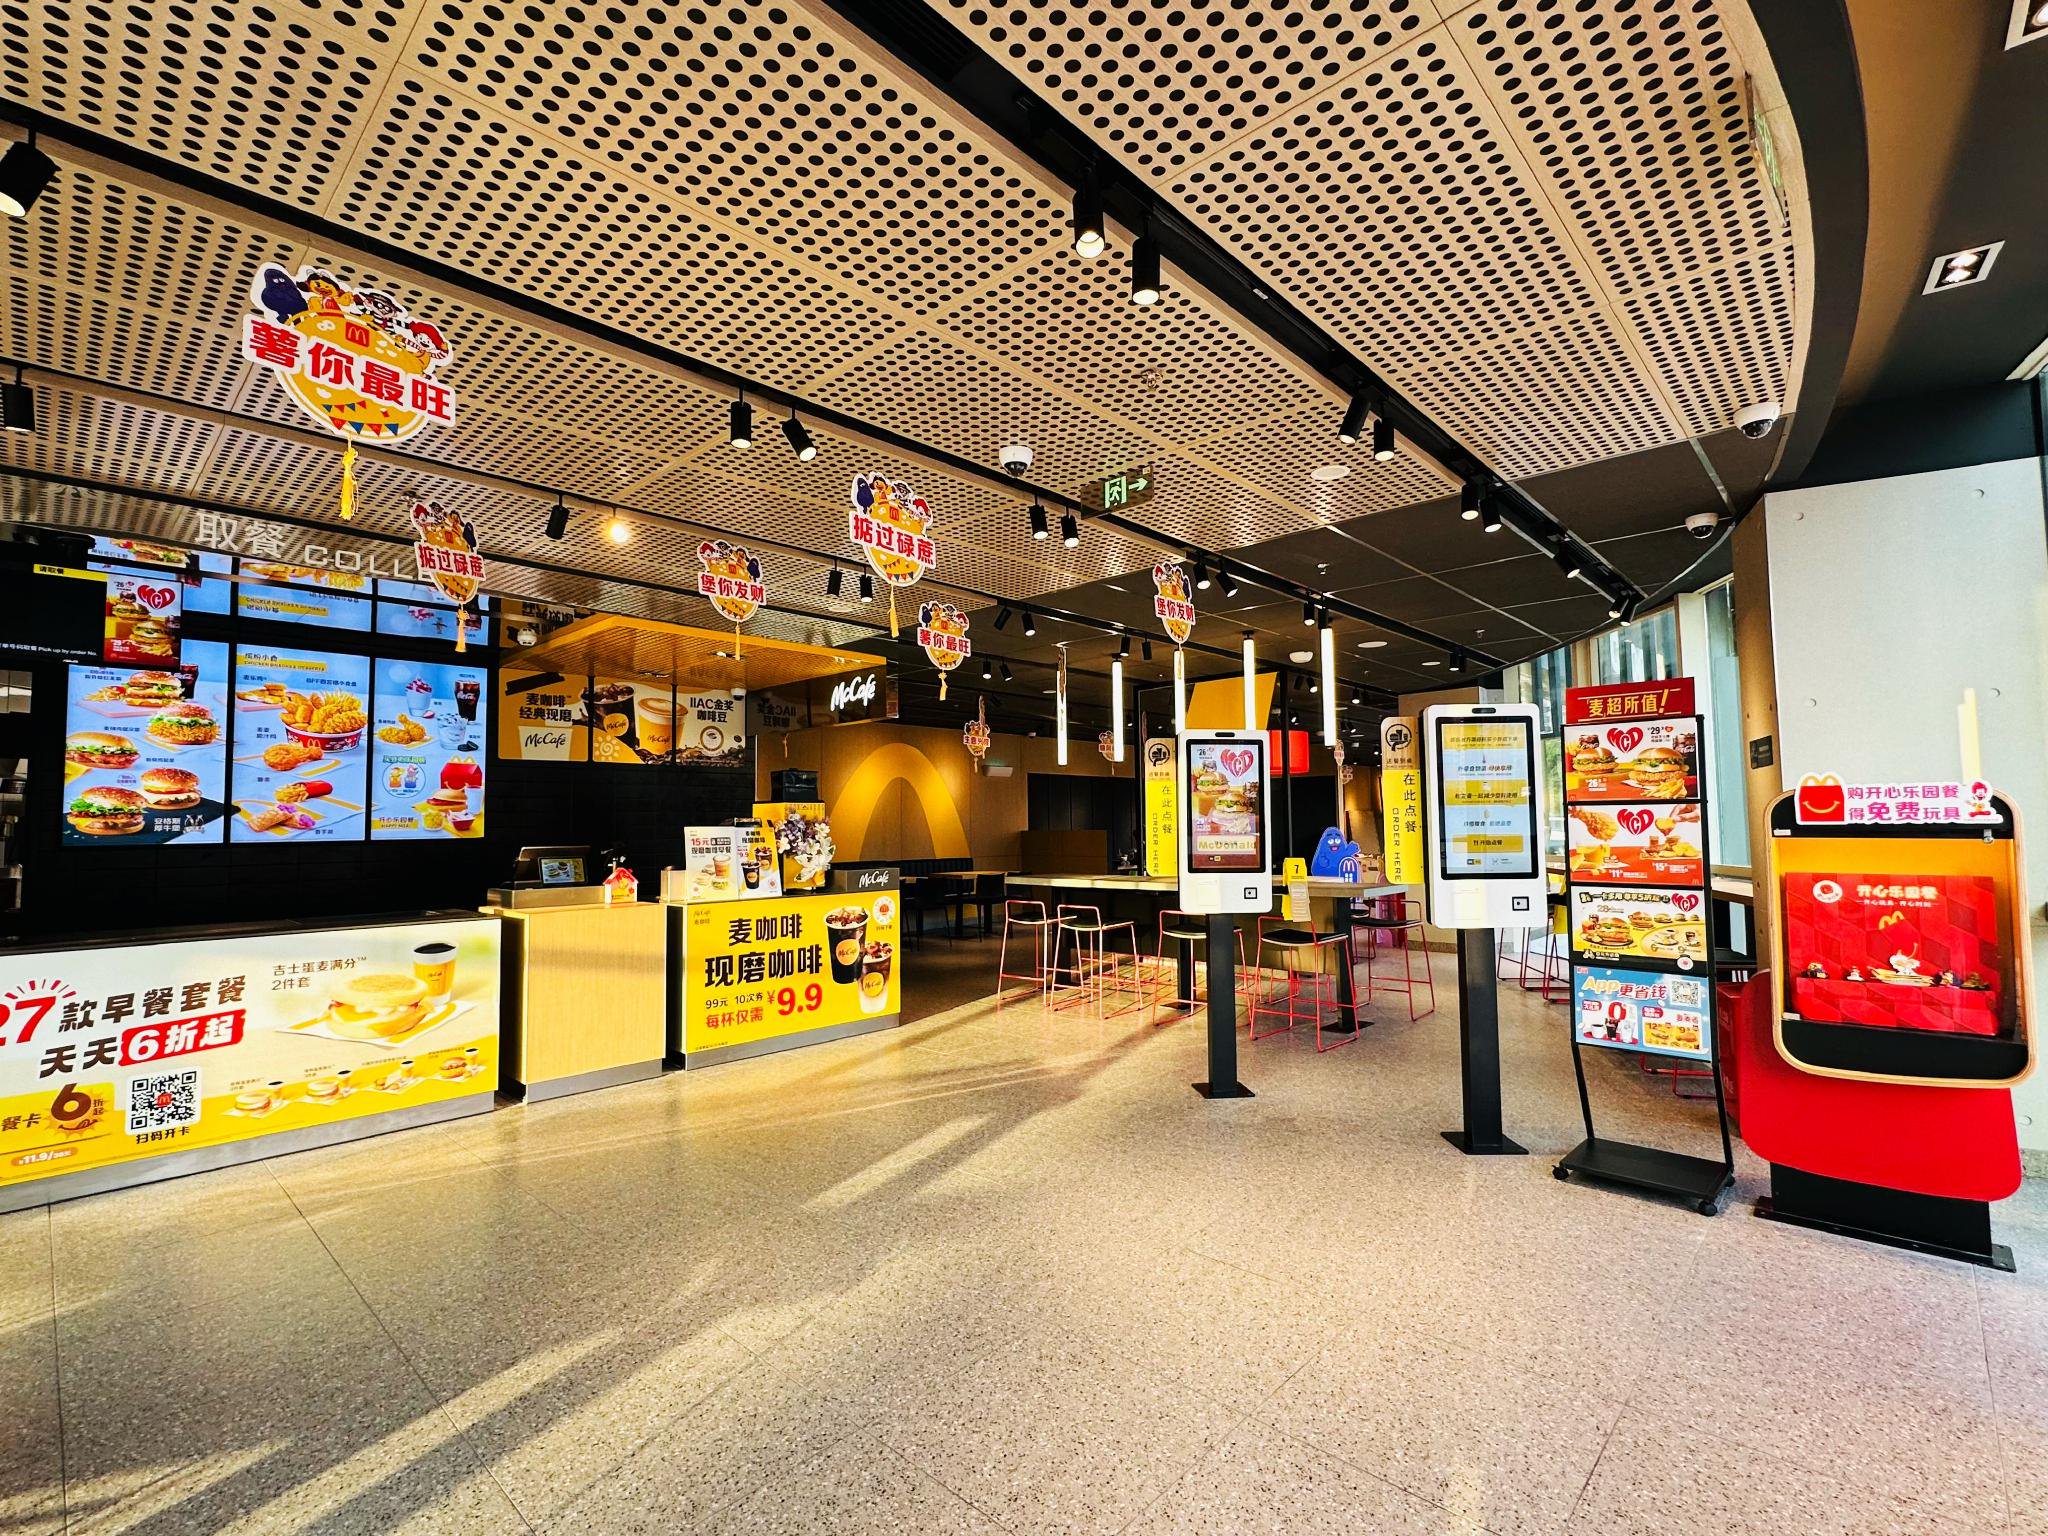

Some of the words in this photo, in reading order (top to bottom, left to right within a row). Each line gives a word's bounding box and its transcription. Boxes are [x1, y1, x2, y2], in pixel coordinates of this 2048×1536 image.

[250, 319, 451, 421] 薯你最旺
[194, 509, 286, 558] 取餐
[853, 515, 935, 565] 掂过碌蔗
[418, 543, 484, 579] 掂过碌蔗
[701, 574, 764, 605] 堡你发财
[1156, 595, 1195, 622] 堡你发财
[920, 629, 969, 655] 薯你最旺
[831, 673, 877, 711] McCafé
[525, 733, 567, 749] McCafé
[1403, 772, 1418, 834] 在此点餐
[1847, 785, 1959, 799] 购开心乐园餐
[1161, 784, 1173, 835] 在此点餐
[1849, 801, 1961, 821] 得免费玩具
[1392, 807, 1400, 847] ORDER
[859, 870, 890, 888] McCafé
[1294, 864, 1300, 874] 7
[1394, 852, 1402, 882] HERE
[1857, 885, 1939, 899] 开心乐园餐
[729, 914, 803, 946] 麦咖啡
[704, 944, 823, 988] 现磨咖啡
[271, 976, 311, 991] 2件套
[1581, 976, 1668, 1000] App更省钱
[58, 975, 246, 1033] 款早餐套餐
[705, 998, 728, 1009] 99元
[735, 992, 763, 1005] 10次券
[766, 983, 823, 1016] ¥9.9
[706, 1007, 763, 1029] 每杯仅需
[39, 1014, 236, 1079] 天天6折起
[51, 1083, 91, 1121] 6
[136, 1126, 190, 1144] 扫码开卡
